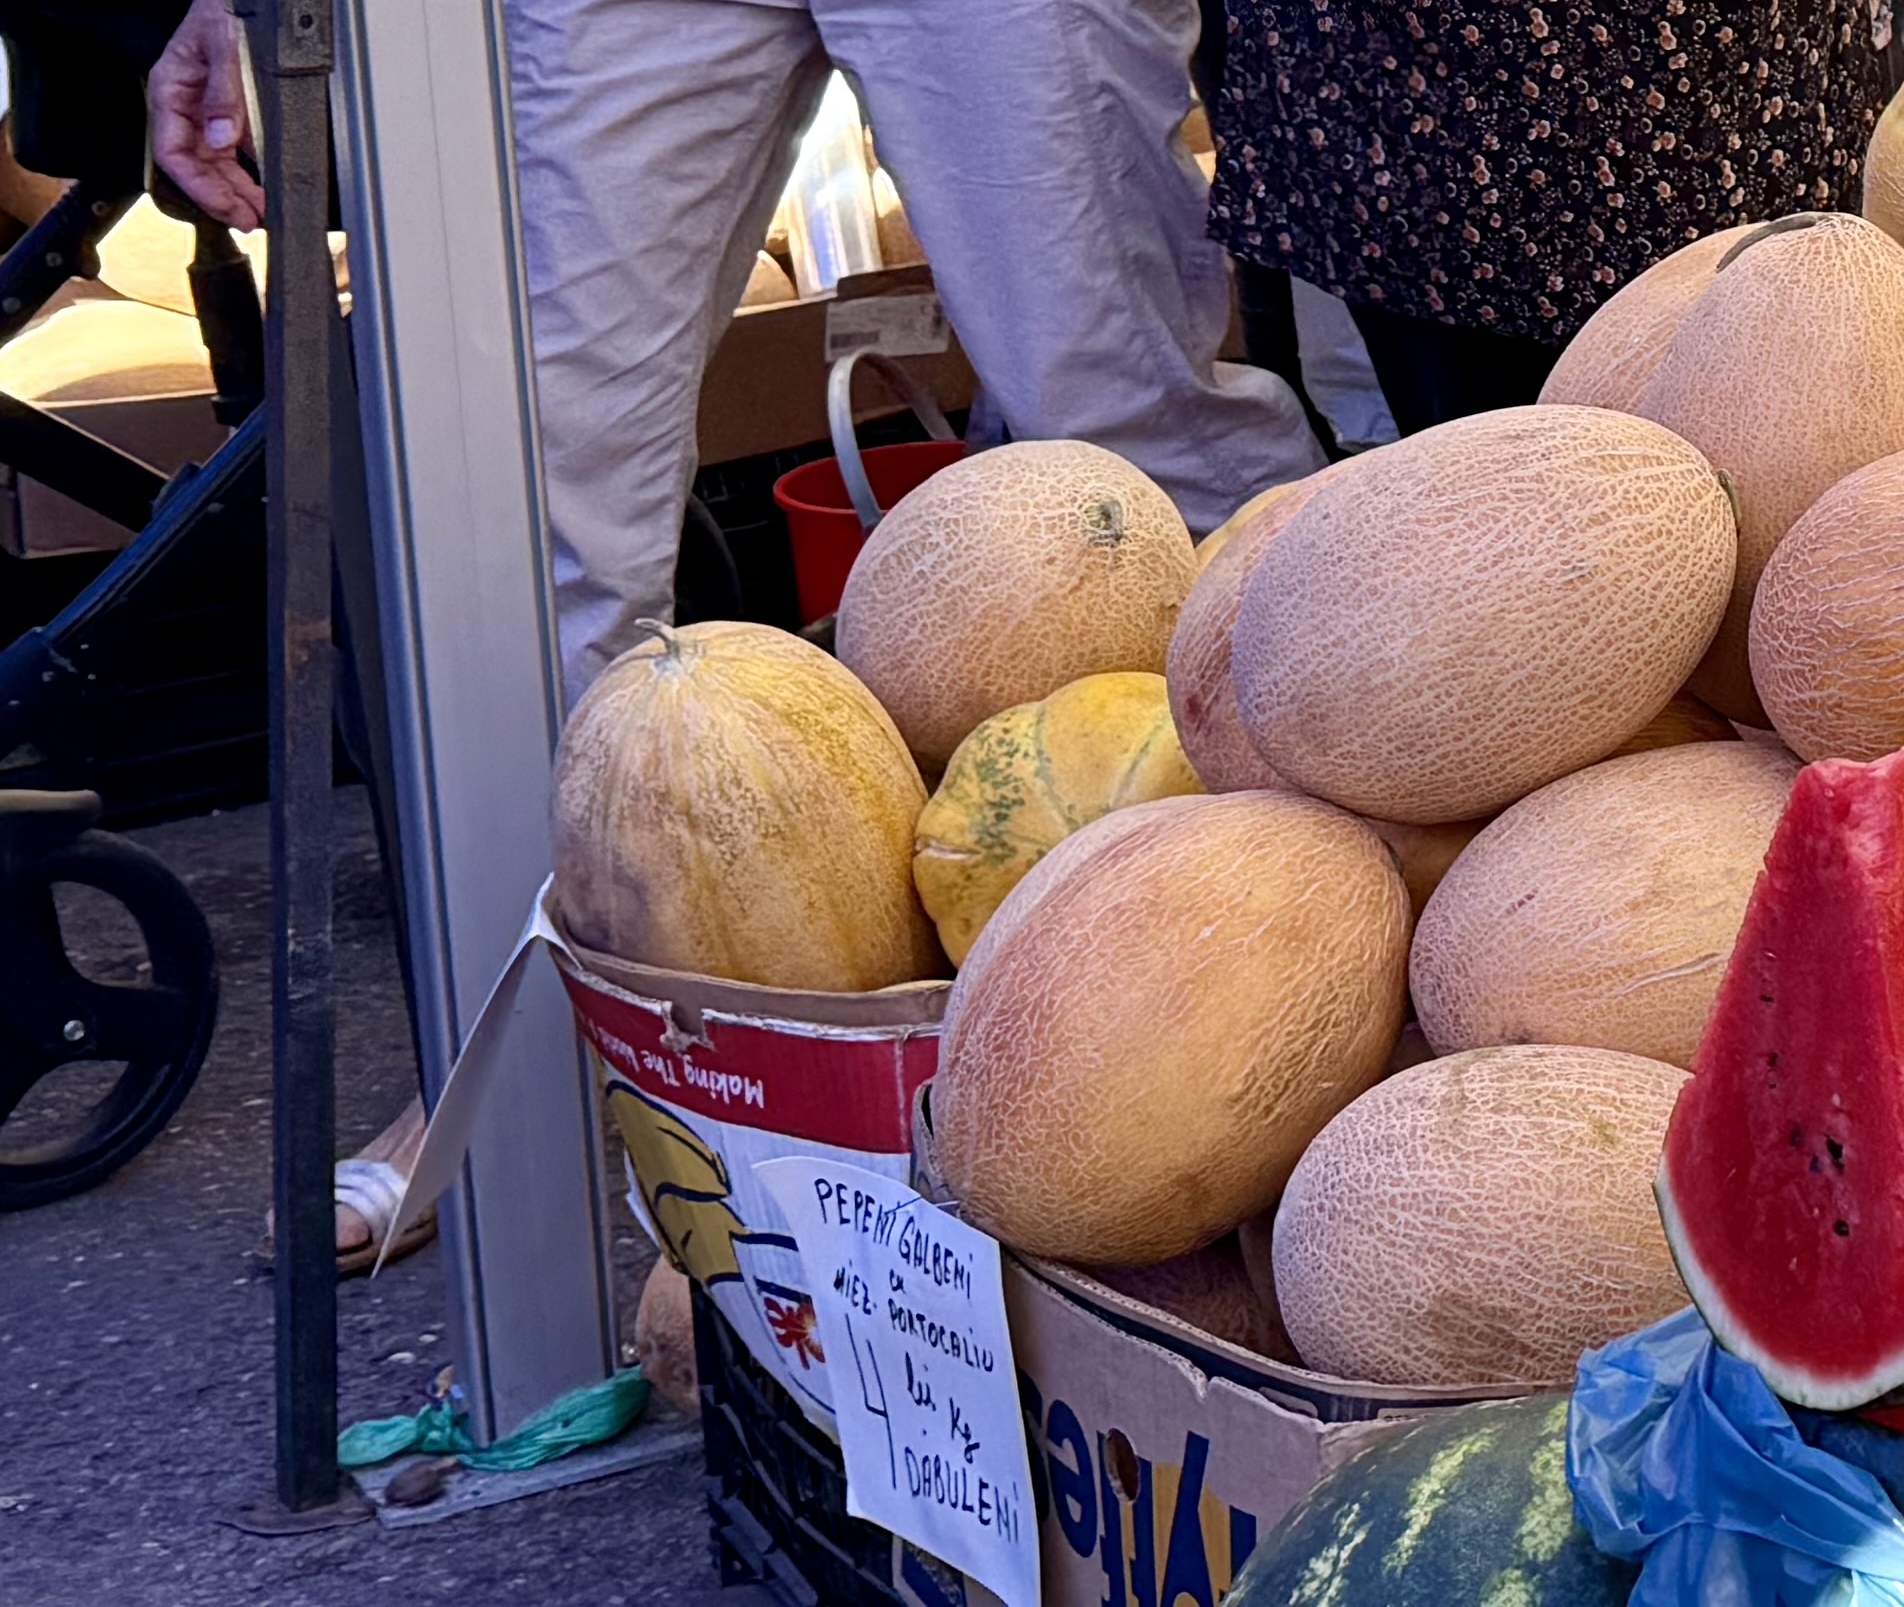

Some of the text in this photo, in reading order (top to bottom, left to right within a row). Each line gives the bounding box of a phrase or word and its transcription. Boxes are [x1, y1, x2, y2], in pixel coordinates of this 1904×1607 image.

[643, 1049, 681, 1088] The
[683, 1053, 765, 1109] Making
[844, 1311, 897, 1491] 4
